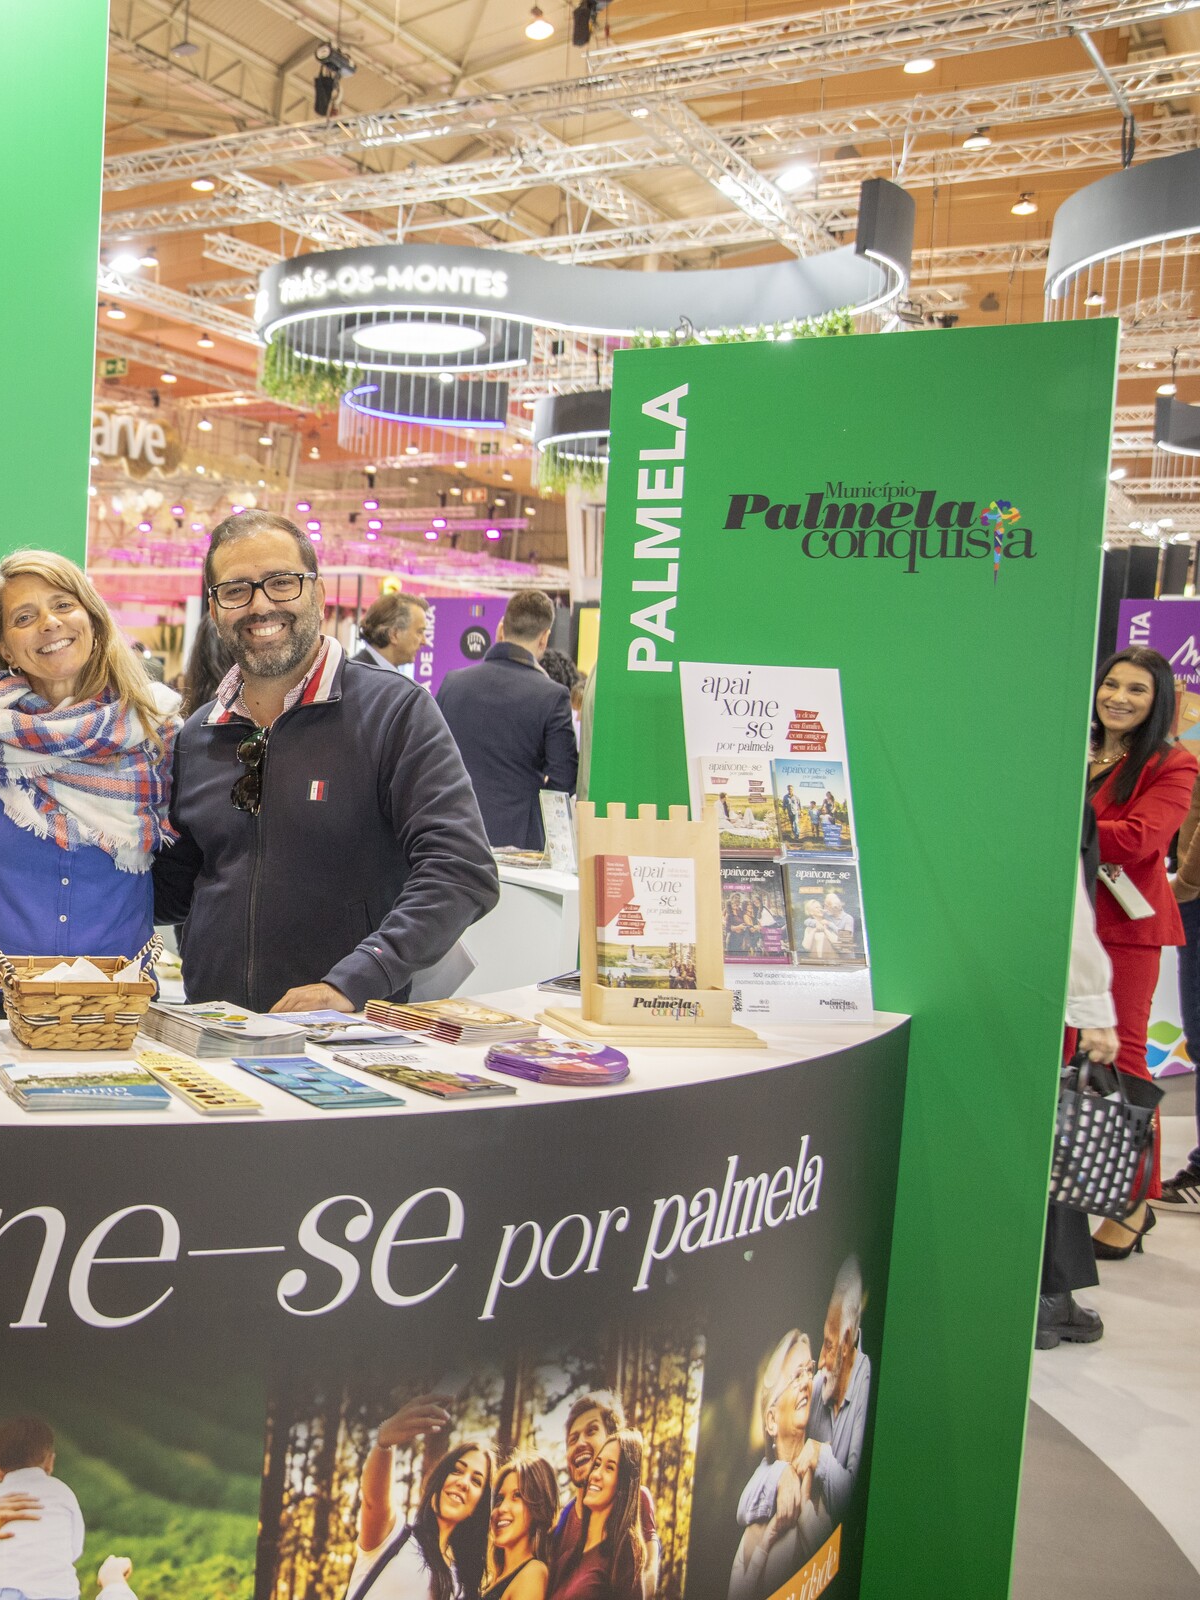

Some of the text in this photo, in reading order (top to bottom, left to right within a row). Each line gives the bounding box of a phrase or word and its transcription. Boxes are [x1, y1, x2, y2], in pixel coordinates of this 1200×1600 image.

[824, 480, 917, 502] Município
[722, 490, 978, 530] Palmela
[627, 383, 689, 673] PALMELA
[701, 671, 752, 701] apai
[721, 698, 780, 718] xone
[716, 741, 774, 754] por palmela
[633, 862, 666, 882] apai
[633, 997, 691, 1009] Palmela
[478, 1206, 630, 1322] por
[632, 1134, 825, 1292] palmela
